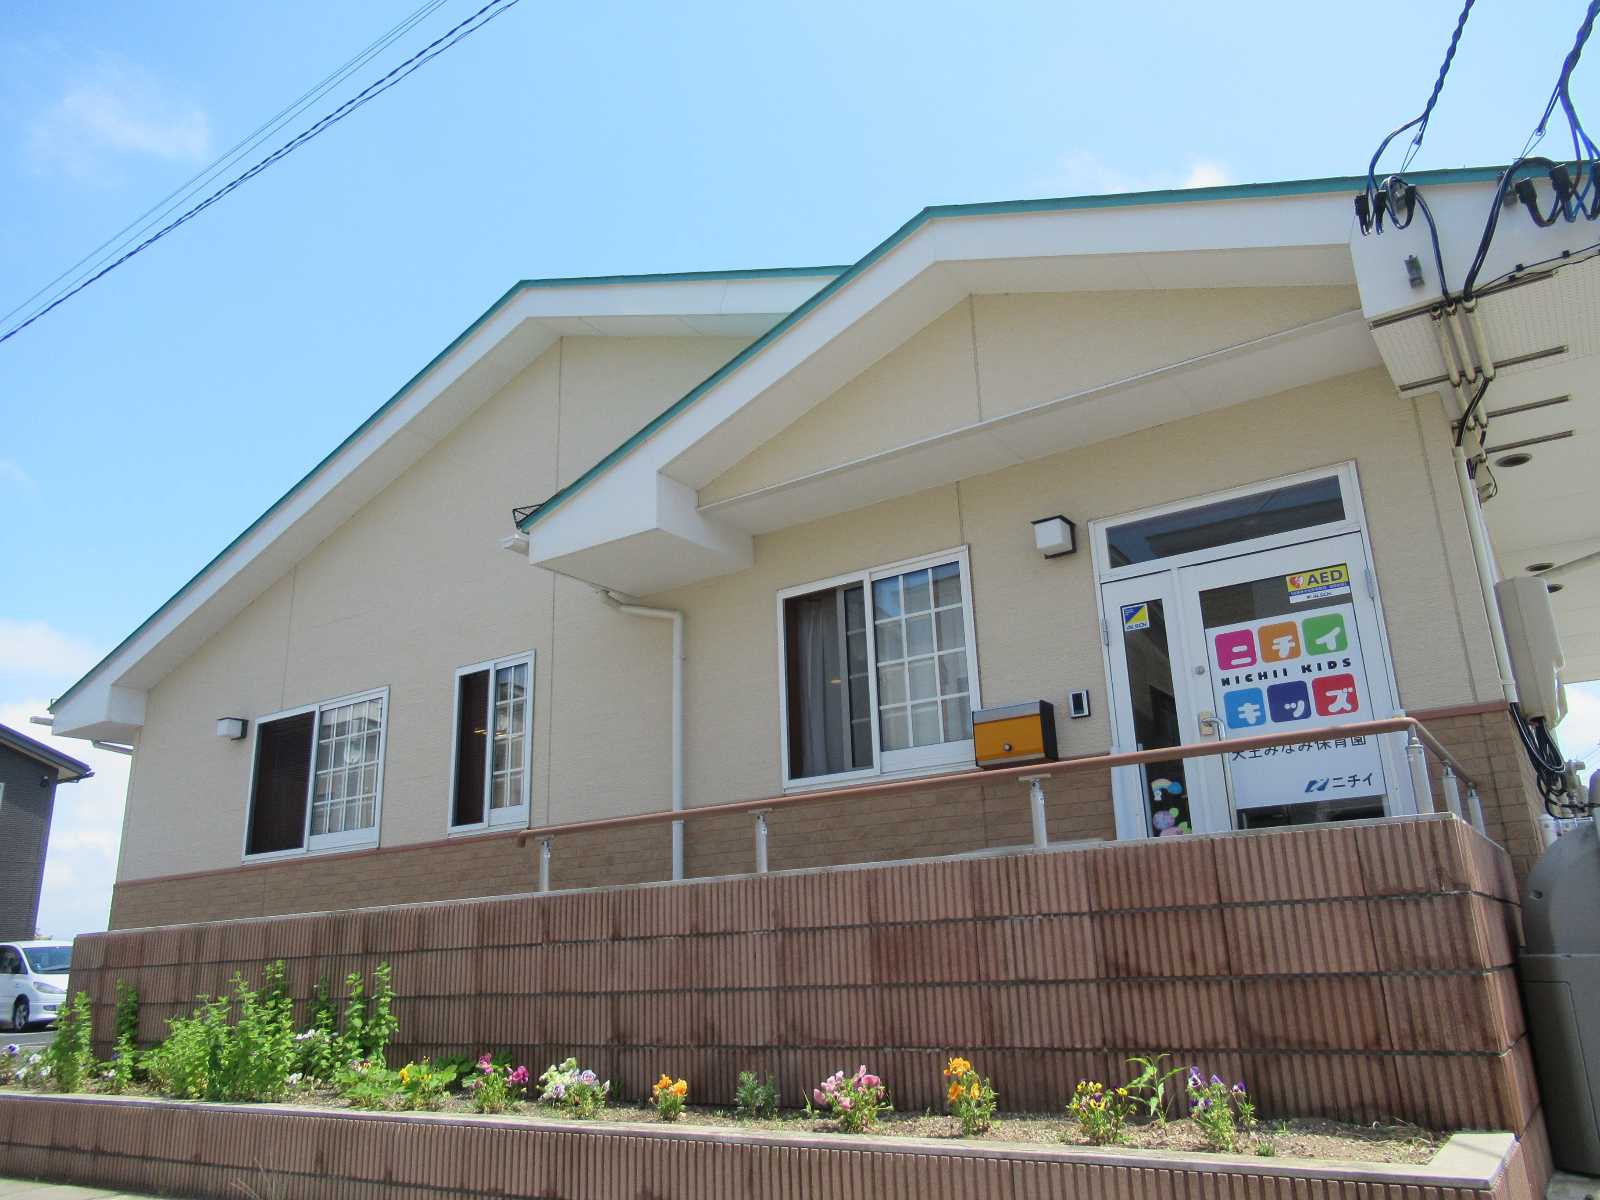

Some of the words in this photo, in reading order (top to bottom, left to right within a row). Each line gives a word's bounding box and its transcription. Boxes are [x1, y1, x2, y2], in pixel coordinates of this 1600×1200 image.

[1307, 569, 1343, 586] AED
[1230, 626, 1342, 666] ニチイ
[1220, 668, 1288, 687] NICHII
[1301, 657, 1352, 674] KIDS
[1237, 686, 1354, 725] キッズ
[1332, 772, 1374, 788] ニチイ
